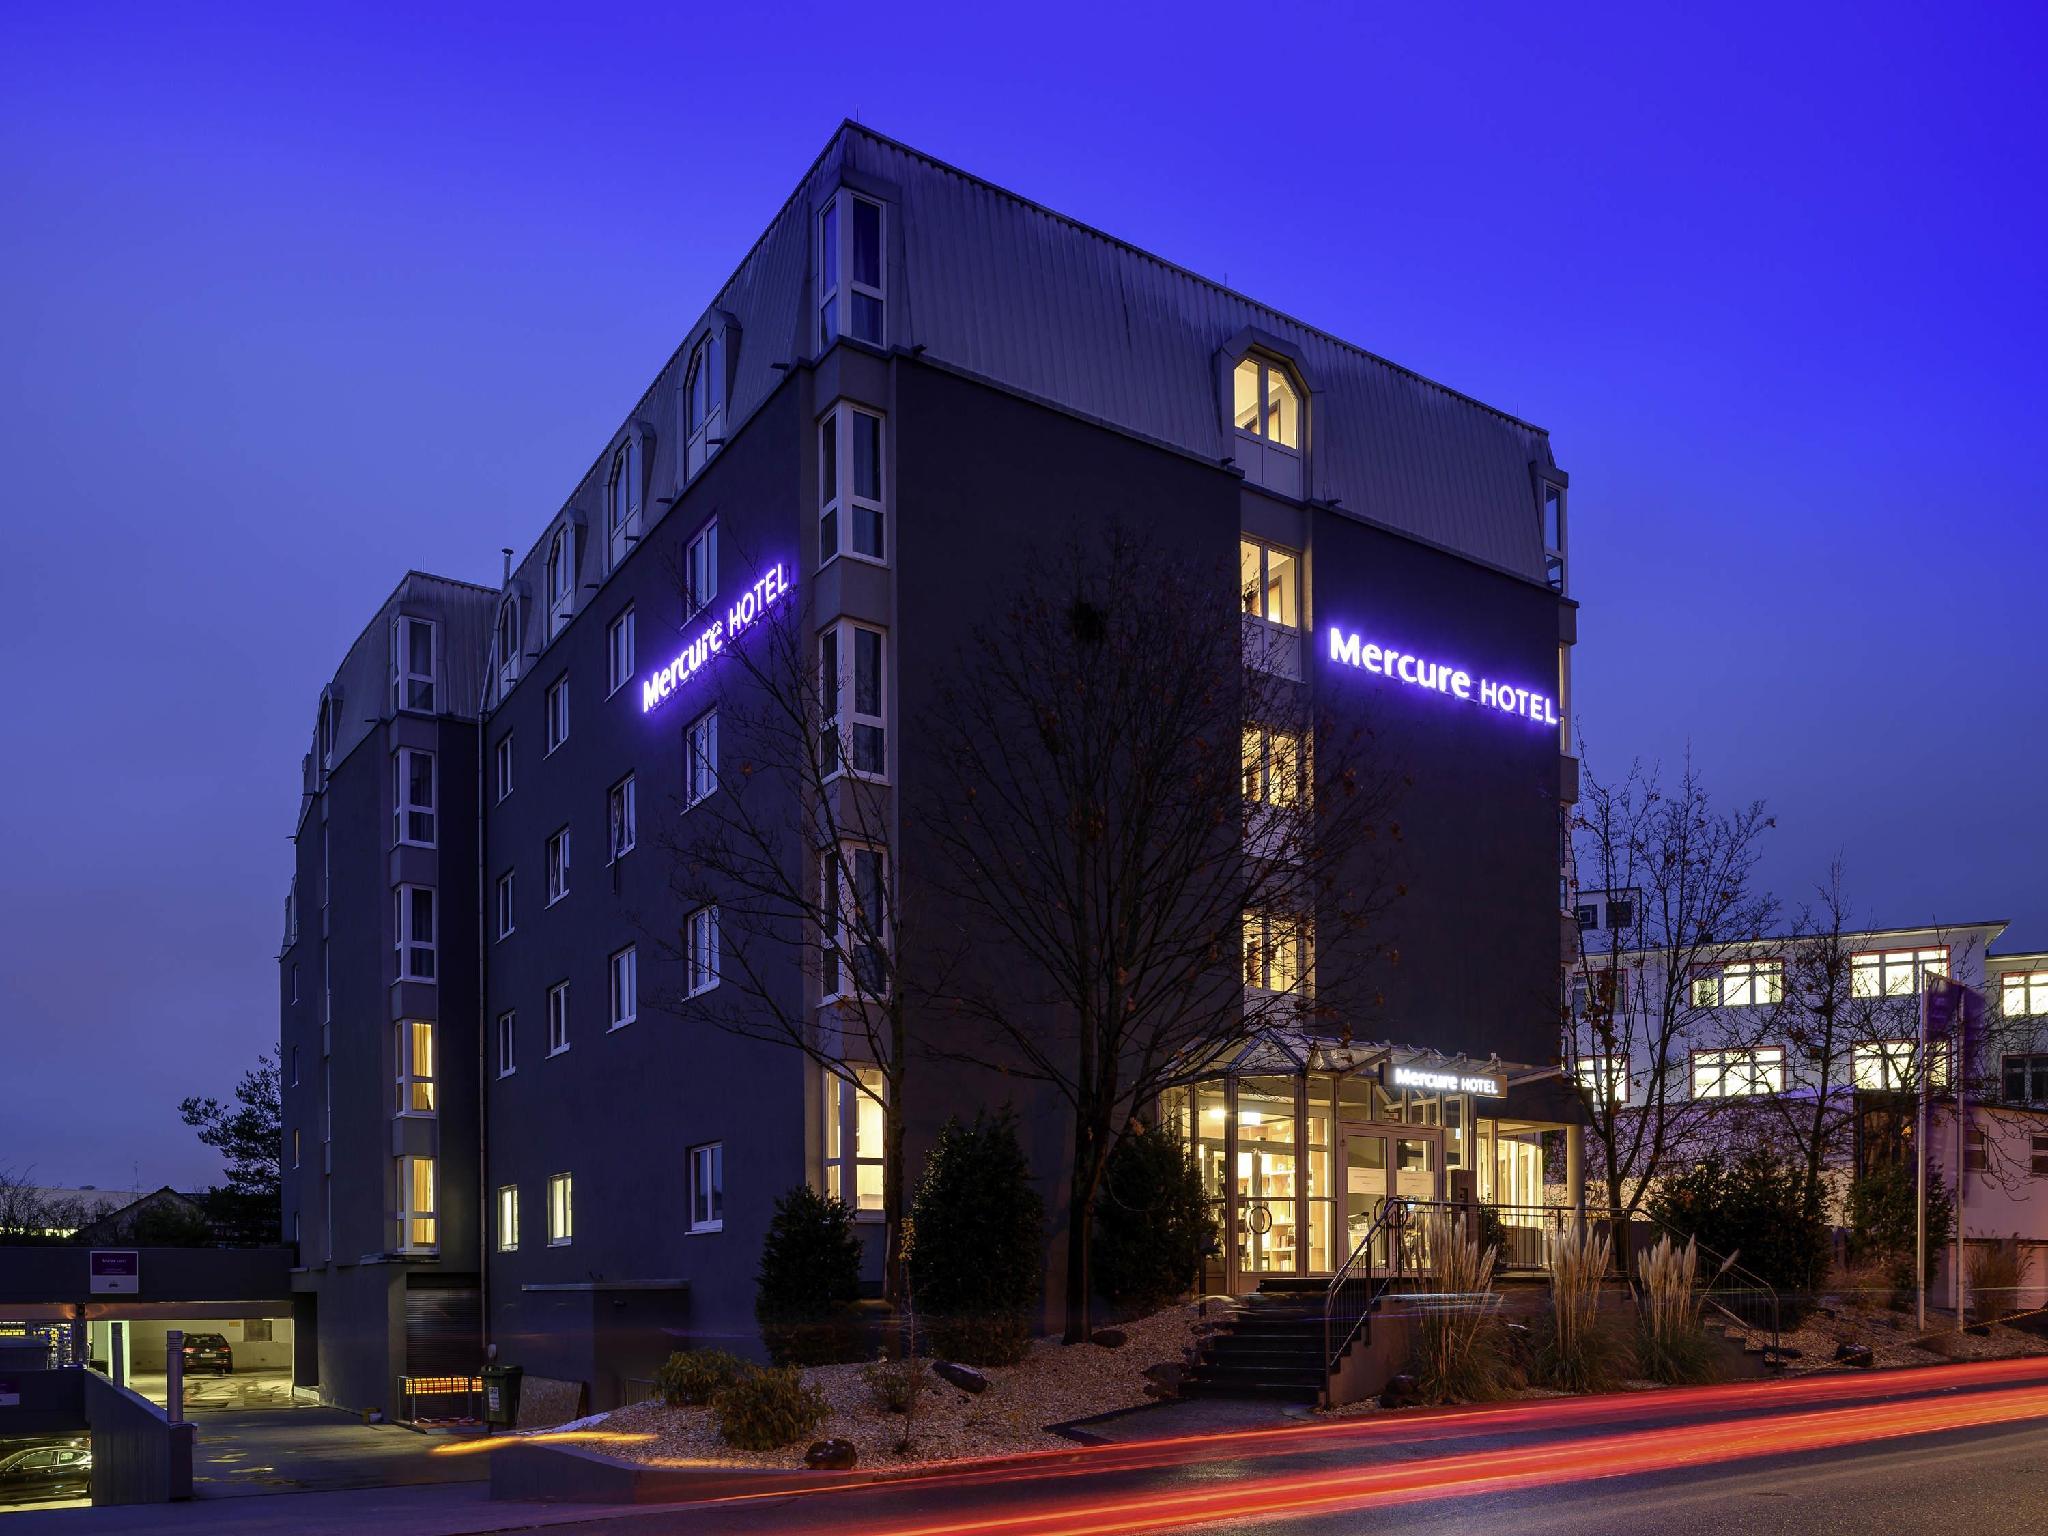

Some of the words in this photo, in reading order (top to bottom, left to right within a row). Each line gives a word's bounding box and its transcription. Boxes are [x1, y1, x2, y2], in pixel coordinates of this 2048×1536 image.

[643, 620, 723, 713] Mercure
[729, 563, 789, 637] HOTEL
[1330, 627, 1471, 698] Mercure
[1480, 678, 1557, 725] HOTEL
[1394, 1067, 1459, 1090] Mercure
[1461, 1077, 1499, 1095] HOTEL
